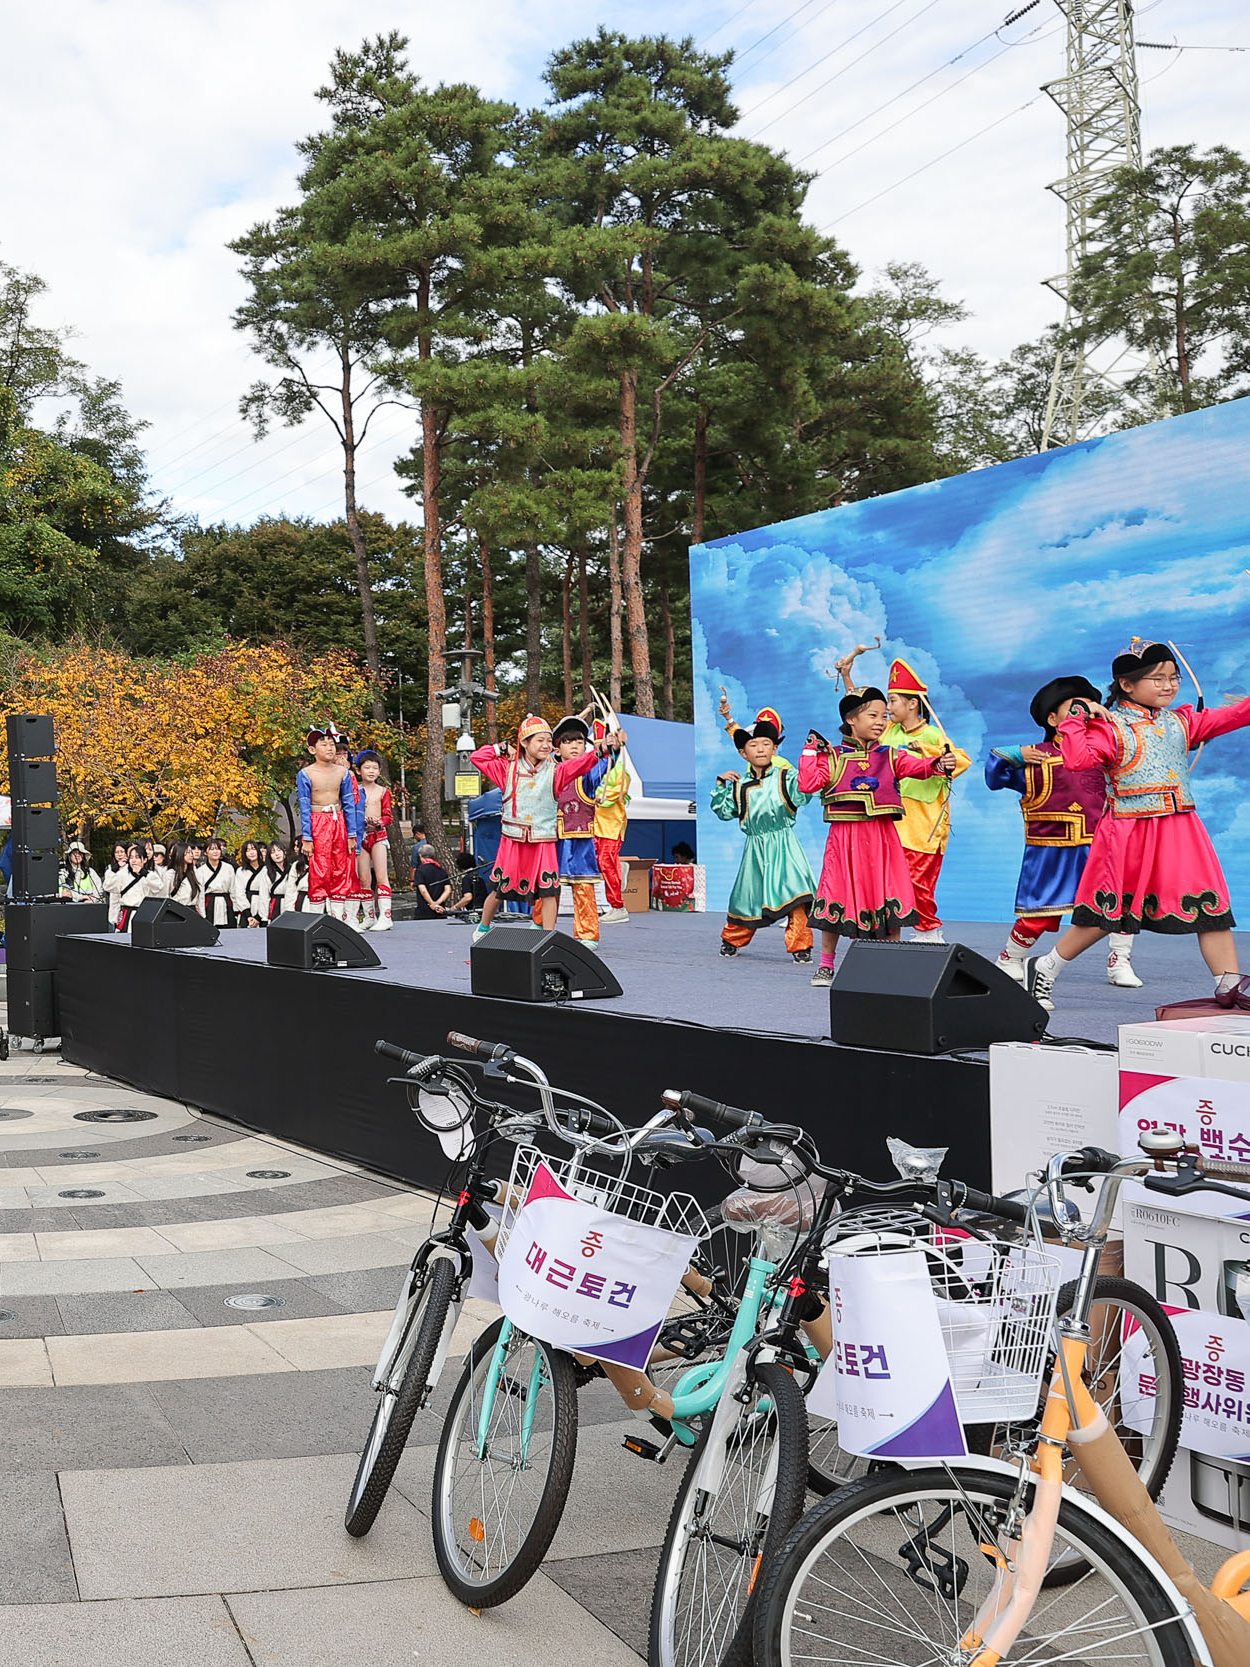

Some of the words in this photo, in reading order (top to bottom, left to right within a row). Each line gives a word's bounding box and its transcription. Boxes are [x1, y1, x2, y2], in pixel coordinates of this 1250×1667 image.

[1196, 1099, 1217, 1126] 증
[580, 1230, 603, 1258] 증
[525, 1241, 638, 1309] 대근토건
[523, 1292, 550, 1311] 광나루
[552, 1307, 580, 1324] 해오름
[582, 1318, 601, 1331] 축제
[1204, 1334, 1225, 1362] 증
[1182, 1357, 1246, 1393] 광장동
